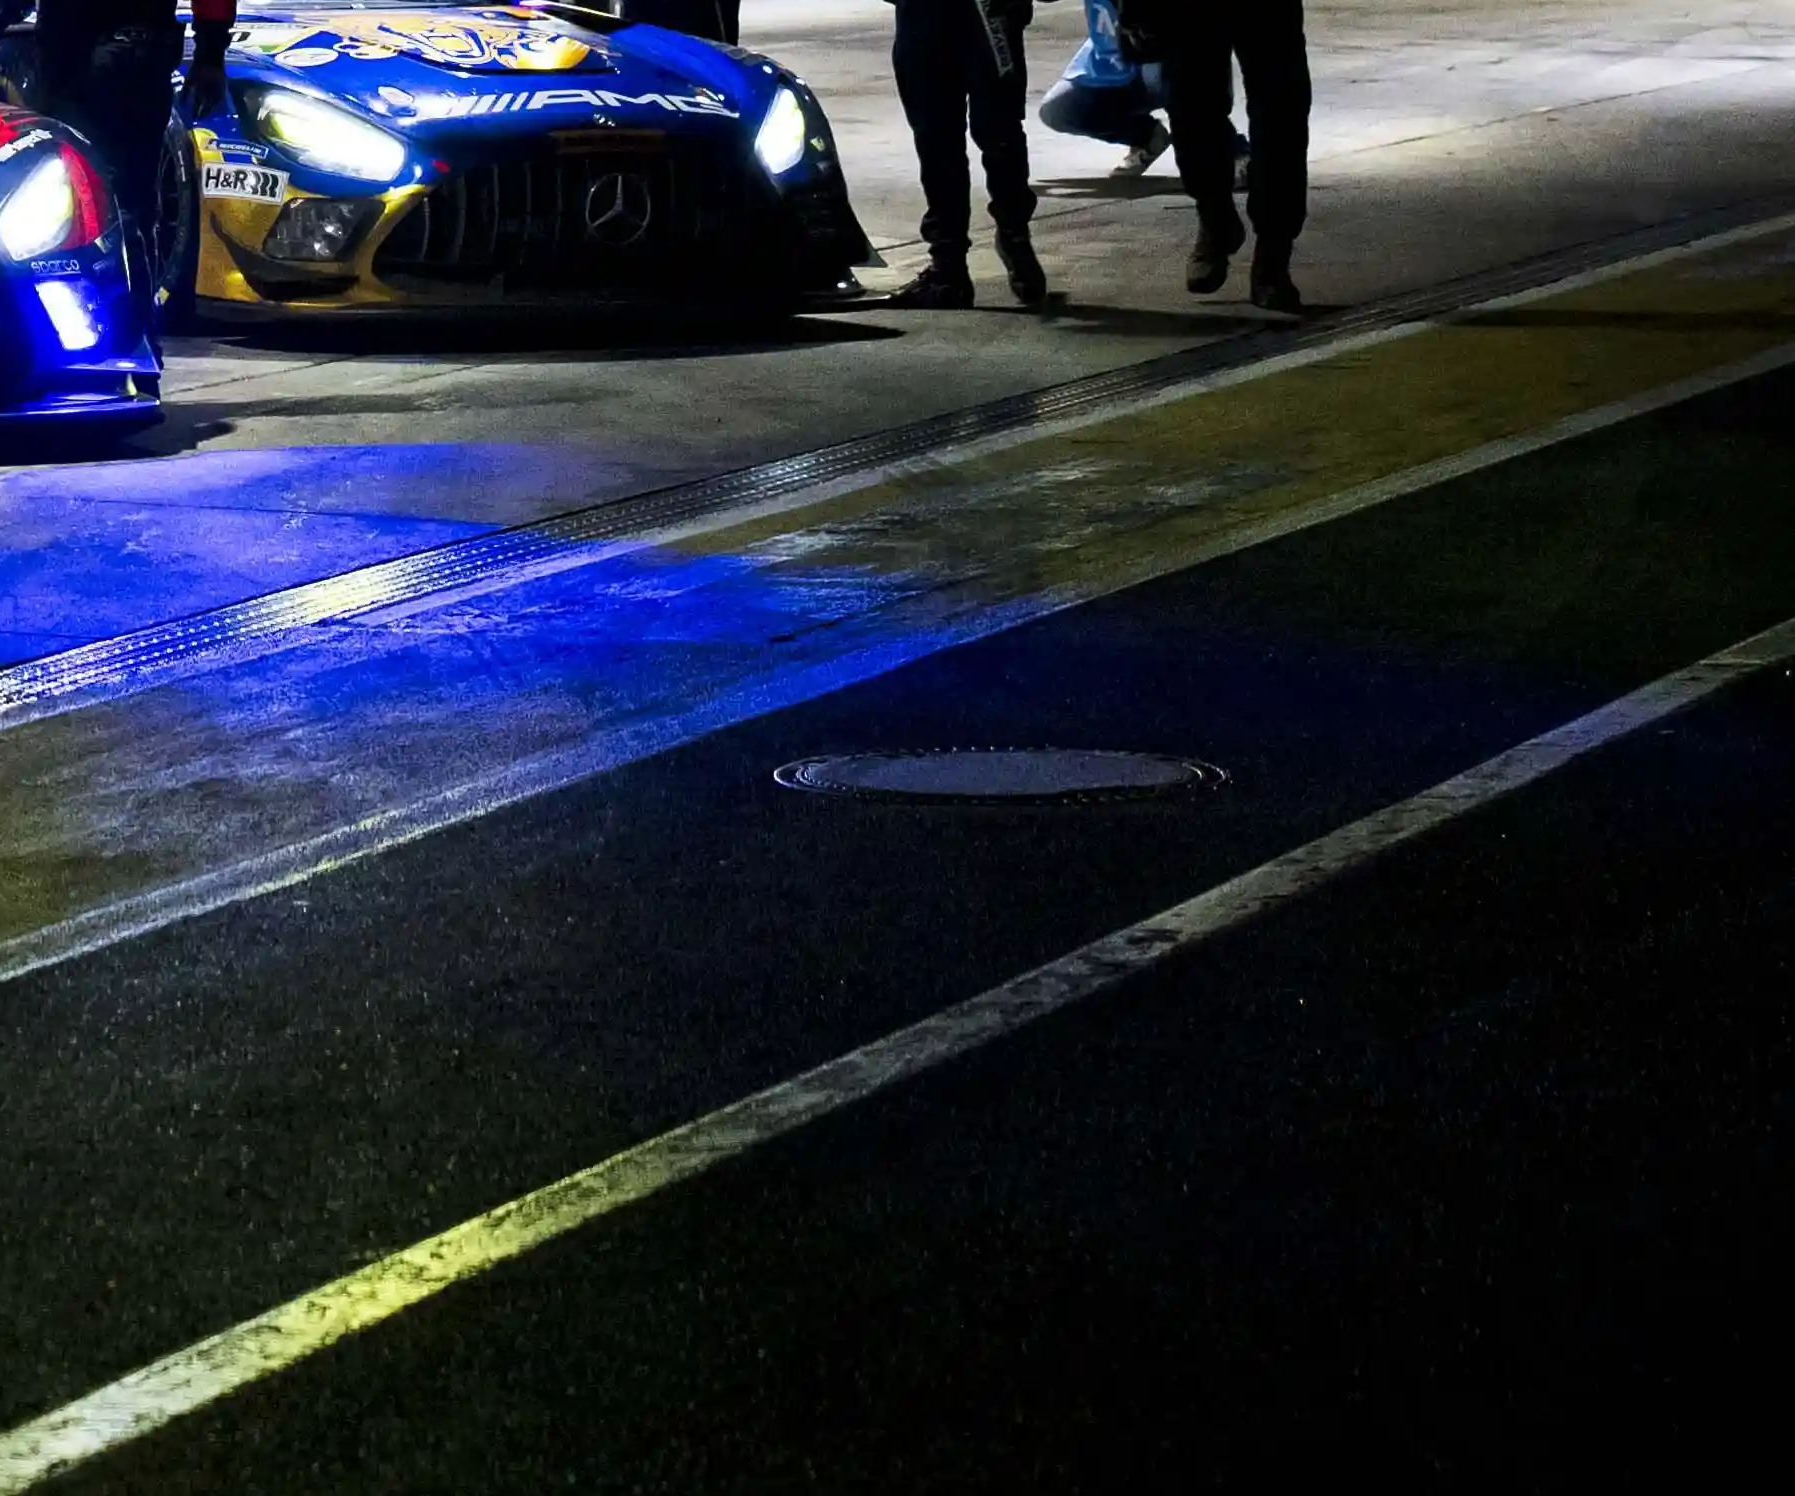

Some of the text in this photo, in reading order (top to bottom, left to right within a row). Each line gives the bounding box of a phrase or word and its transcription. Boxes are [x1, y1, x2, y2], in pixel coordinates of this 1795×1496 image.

[526, 88, 740, 118] AMG
[205, 168, 248, 190] H&R
[31, 260, 81, 273] sparco
